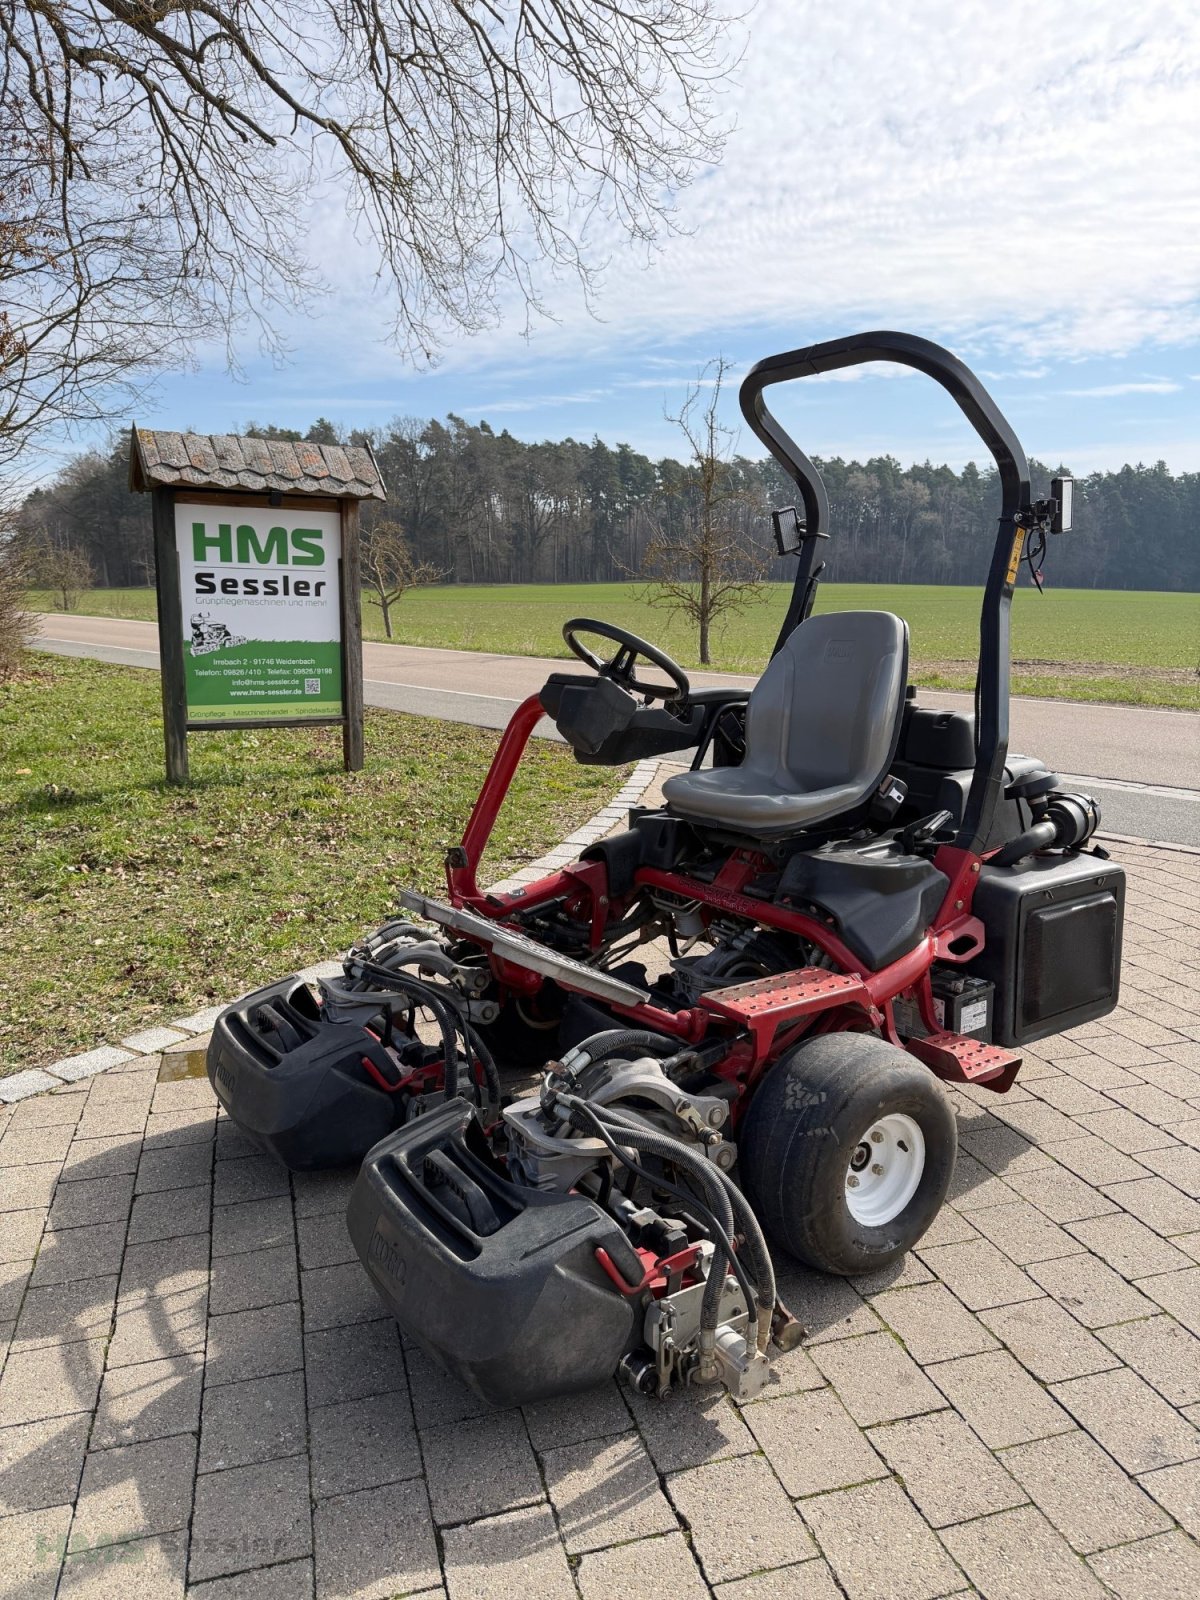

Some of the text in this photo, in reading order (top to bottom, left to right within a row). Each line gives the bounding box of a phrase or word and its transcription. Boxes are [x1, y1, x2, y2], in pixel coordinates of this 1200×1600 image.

[192, 522, 325, 566] HMS
[195, 572, 326, 597] Sessler
[195, 596, 286, 607] Grünpflegemaschinen
[288, 598, 304, 607] und
[242, 658, 248, 666] 2
[252, 658, 275, 666] 91746
[275, 657, 316, 665] Weidenbach
[231, 678, 300, 686] info@hms-sessler.de
[229, 688, 303, 697] www.hms-sessler.de
